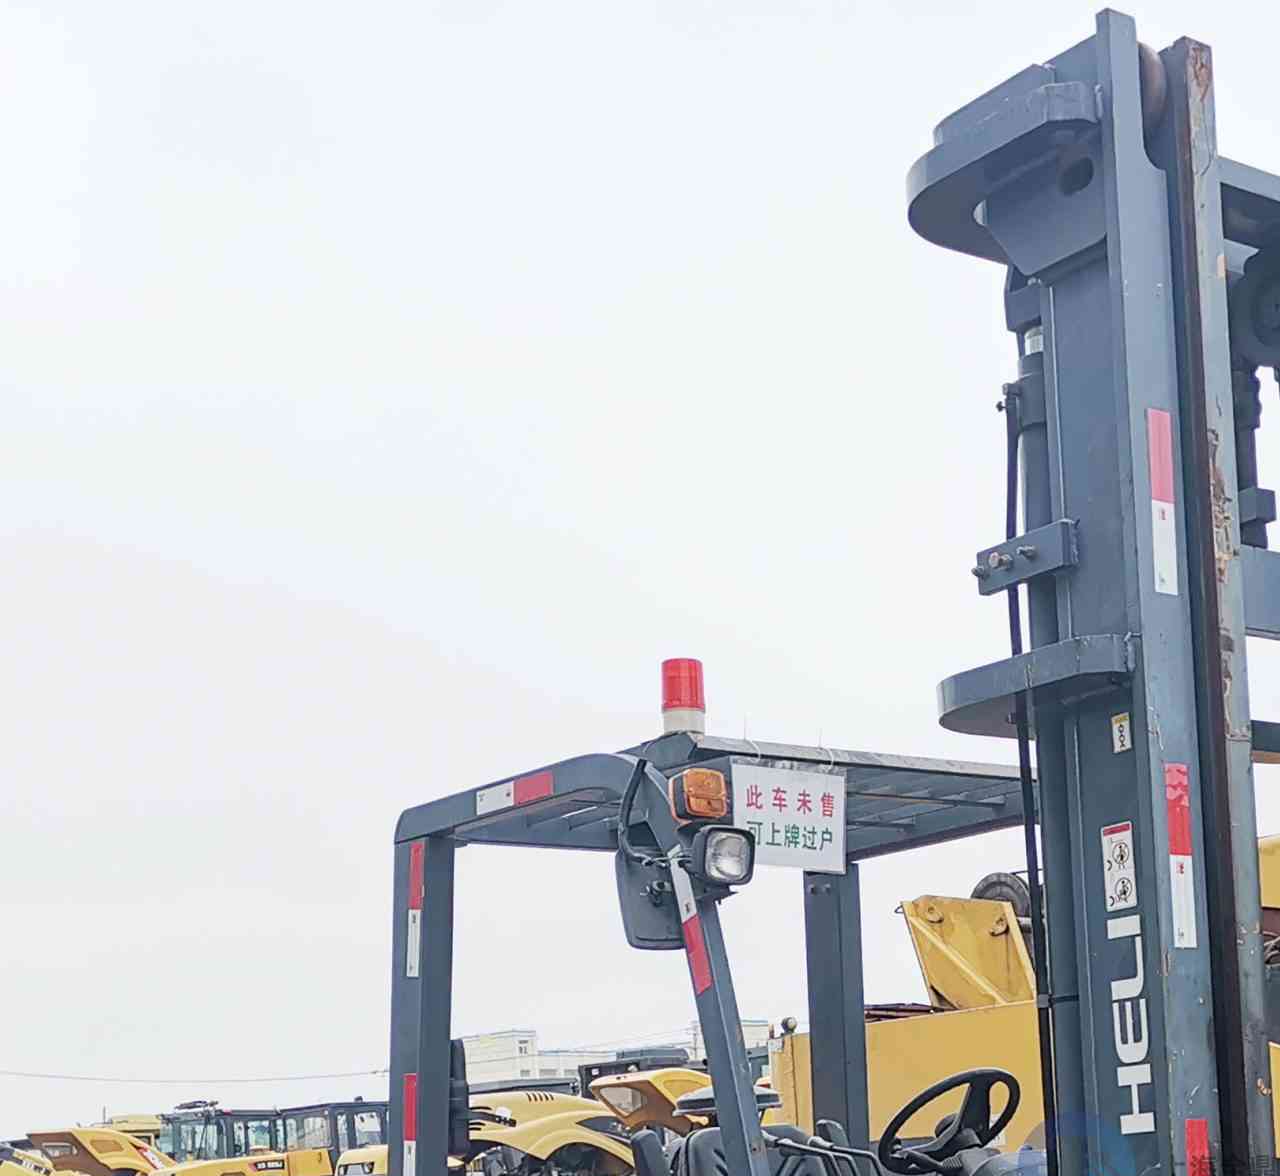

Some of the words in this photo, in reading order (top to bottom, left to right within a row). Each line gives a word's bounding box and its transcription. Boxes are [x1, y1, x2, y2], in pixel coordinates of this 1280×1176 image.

[746, 784, 834, 817] 此车未售
[1107, 914, 1156, 1134] HELI
